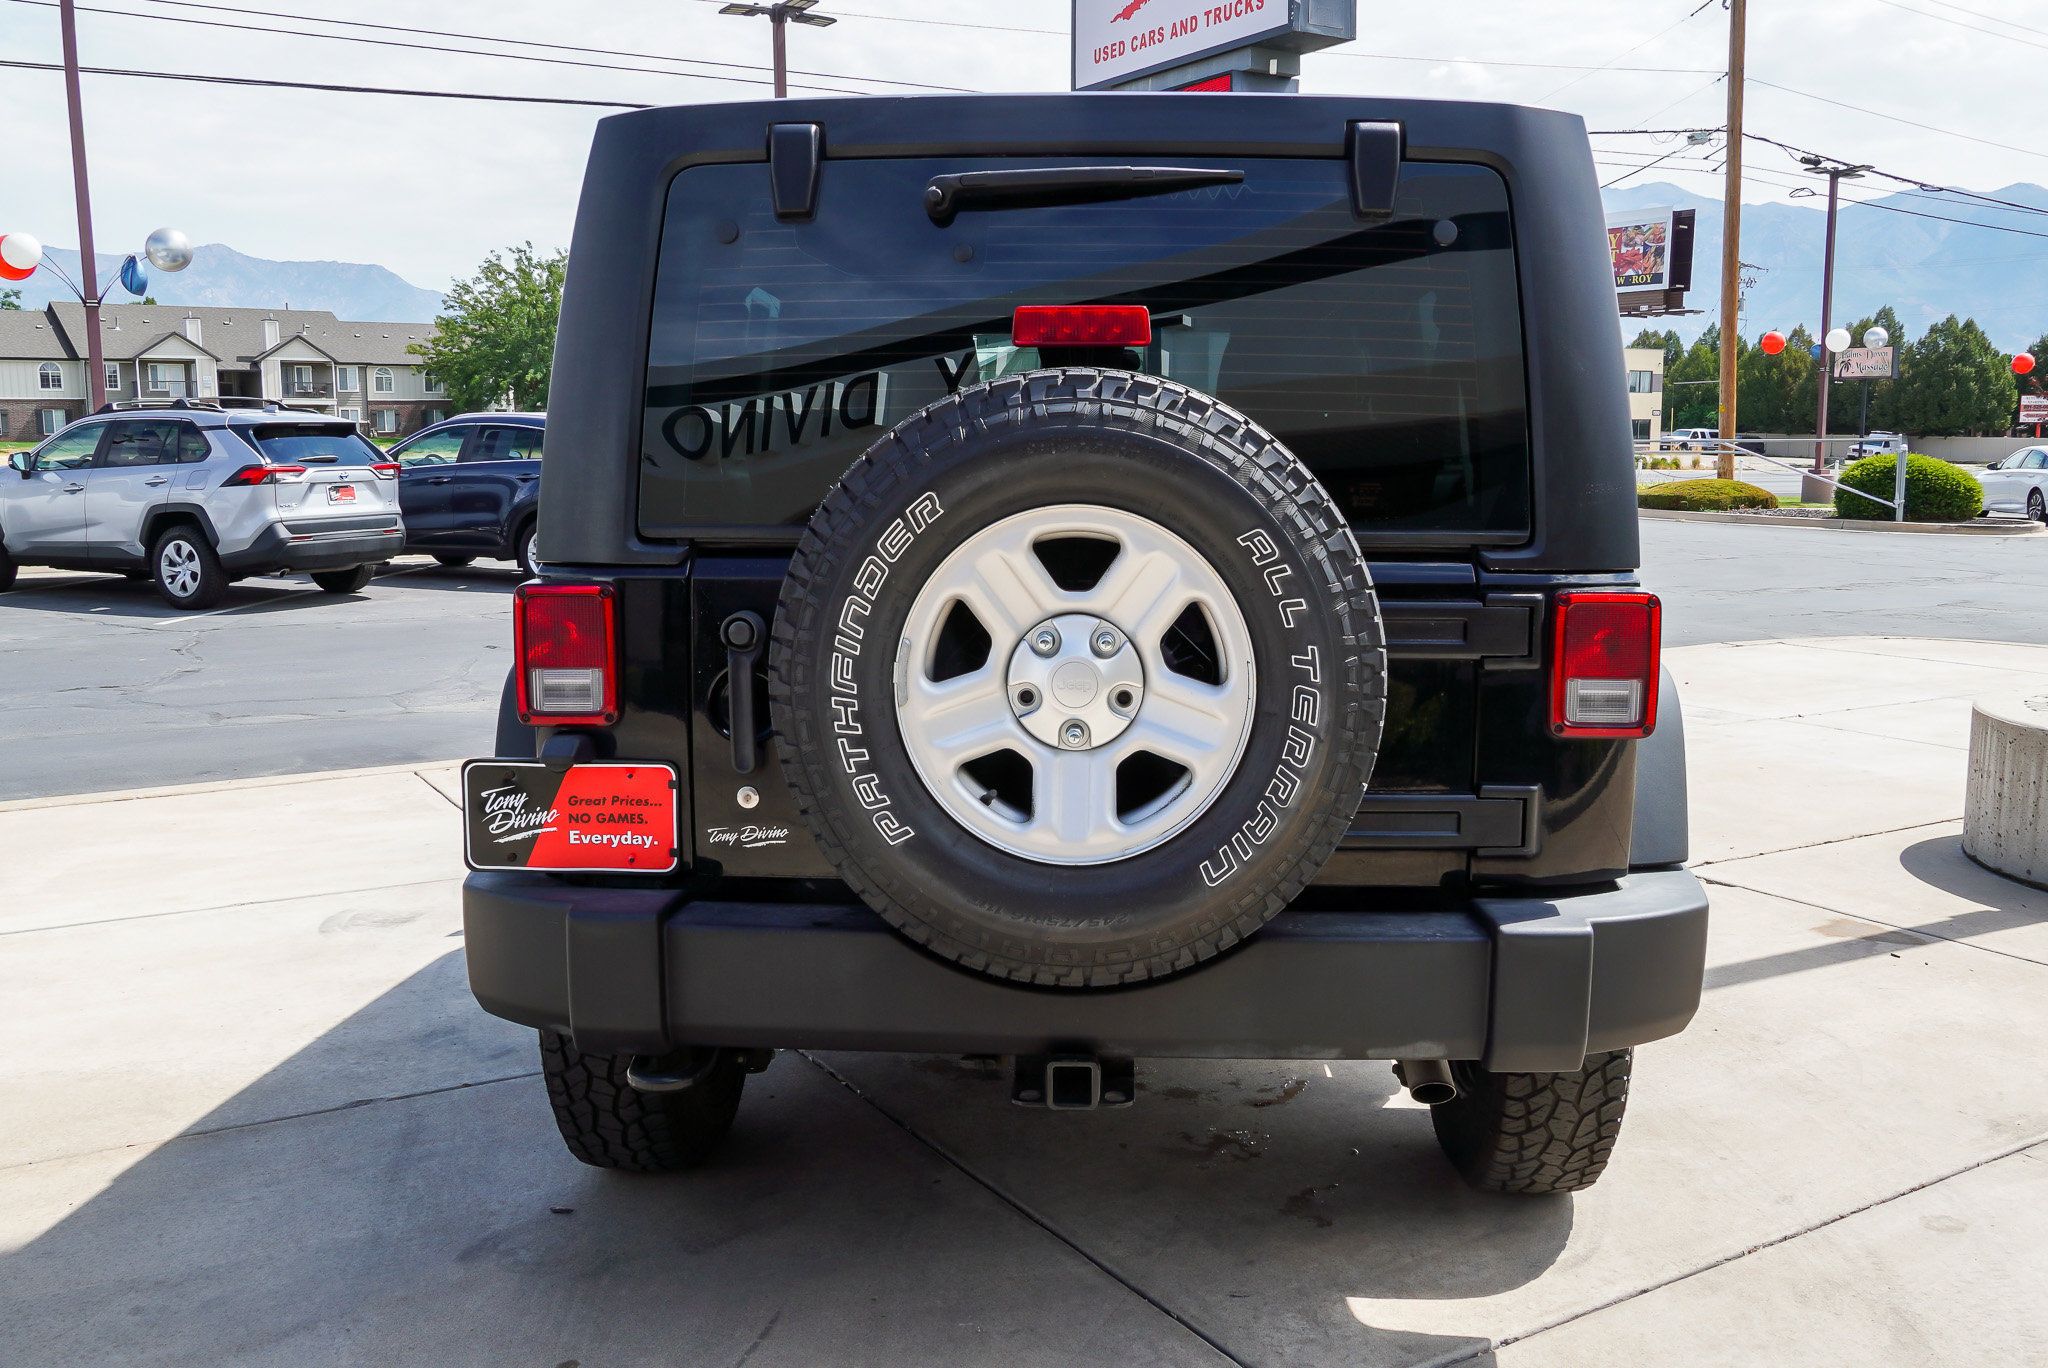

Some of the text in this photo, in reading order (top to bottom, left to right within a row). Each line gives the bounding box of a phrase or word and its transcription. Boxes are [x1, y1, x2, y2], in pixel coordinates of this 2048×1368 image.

[1094, 0, 1265, 65] USED CARS AND TRUCKS
[1851, 362, 1889, 374] Massage
[831, 491, 944, 845] PATHFINDER
[1199, 528, 1321, 887] ALL TERRAIN
[481, 785, 529, 814] Tony
[568, 795, 663, 807] Great Prices...
[482, 806, 560, 834] Divino
[568, 813, 648, 824] NO GAMES.
[568, 830, 659, 848] Everyday.
[707, 825, 789, 846] Tony Divino
